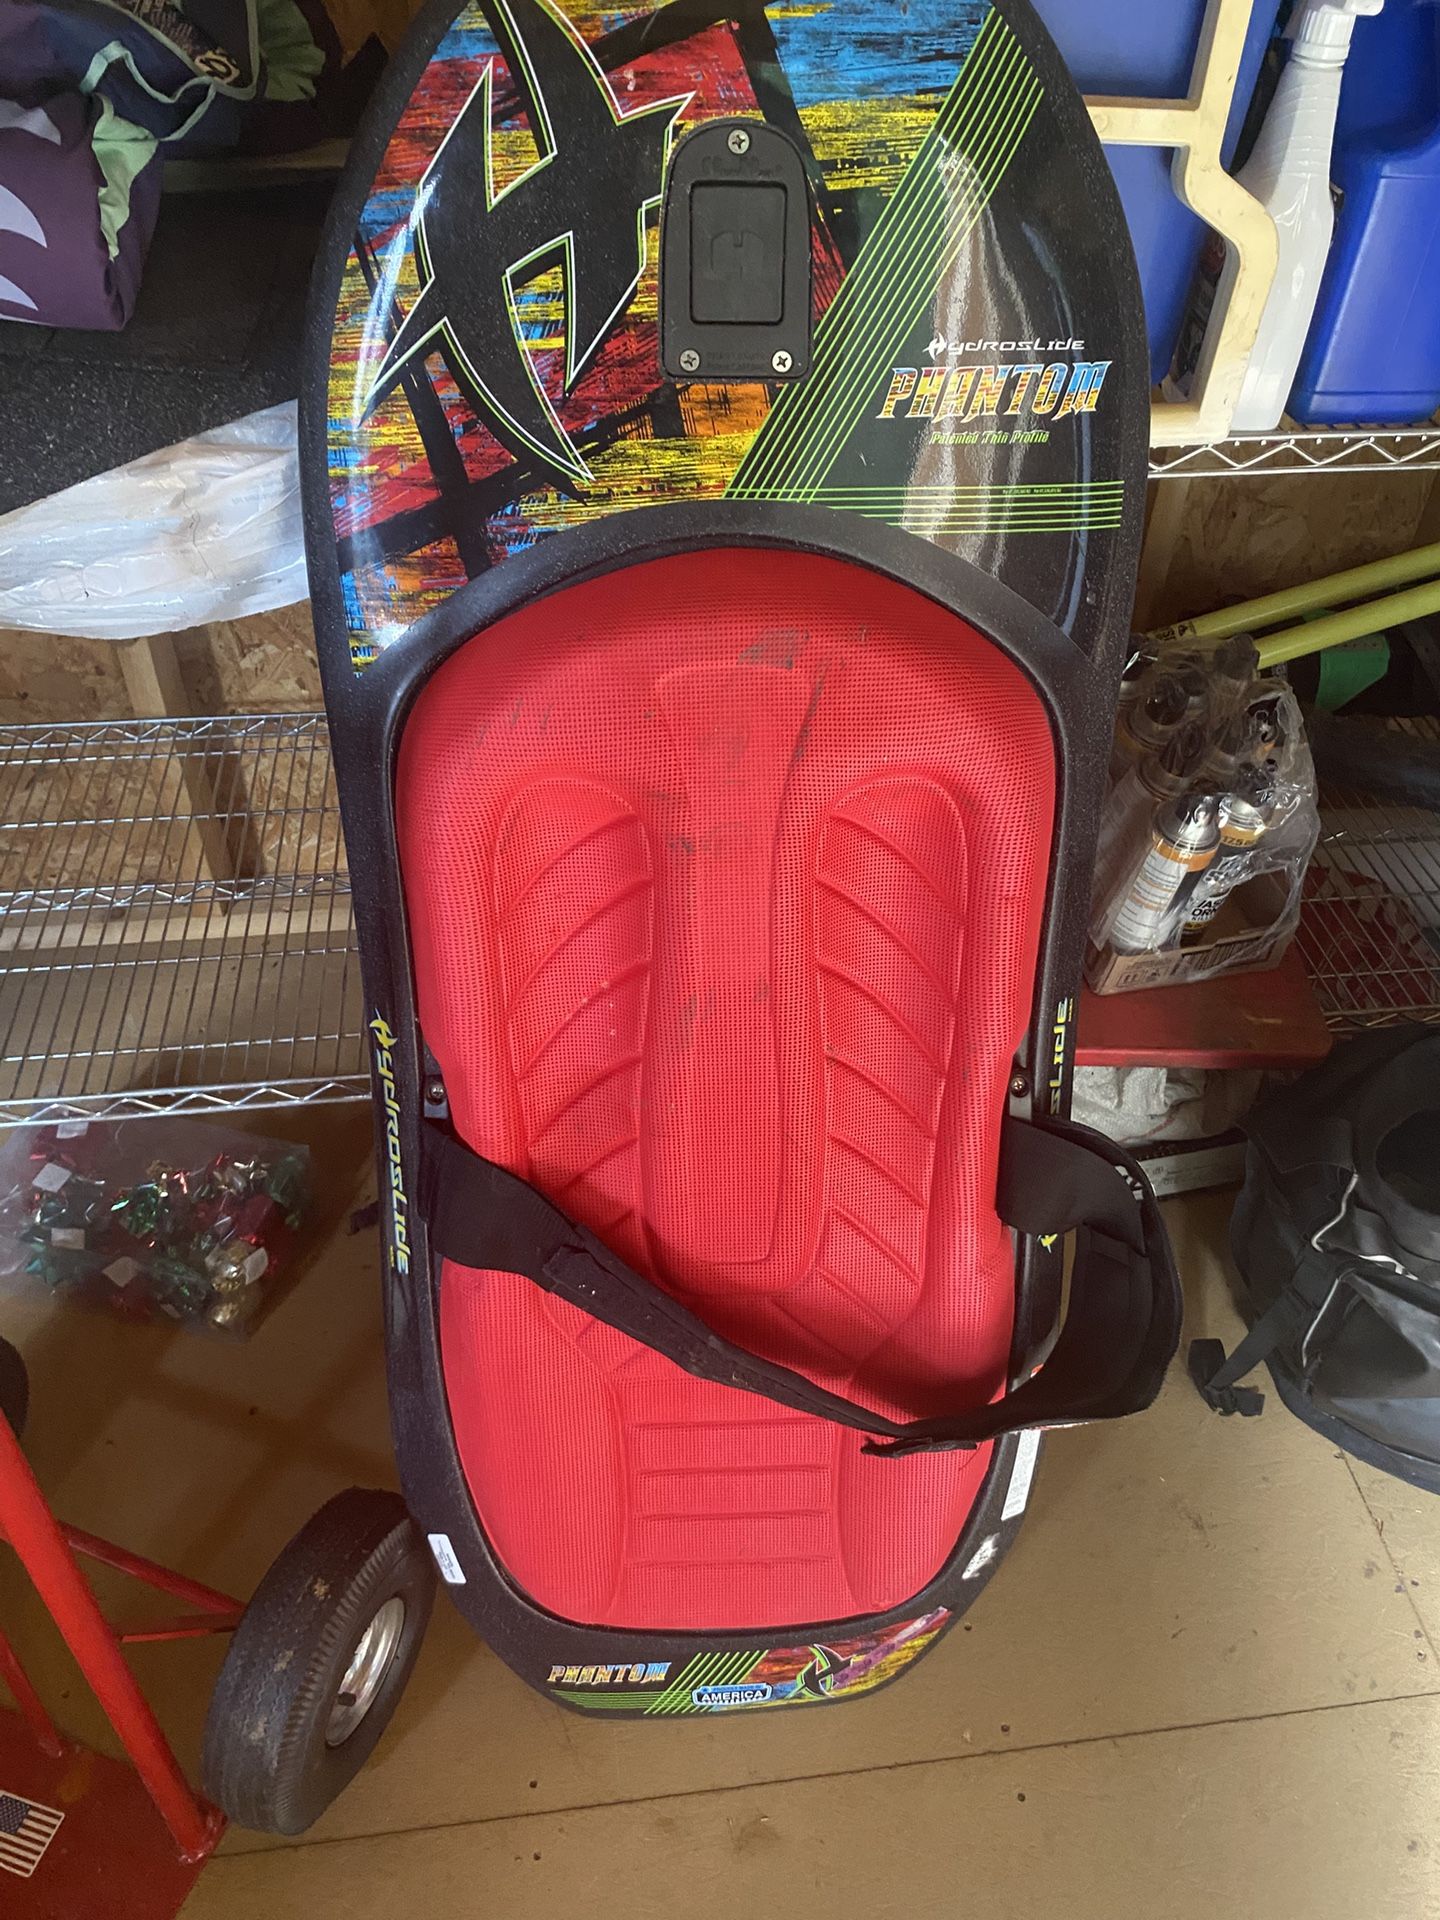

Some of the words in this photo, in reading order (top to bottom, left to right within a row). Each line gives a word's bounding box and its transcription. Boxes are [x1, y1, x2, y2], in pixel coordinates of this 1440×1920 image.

[876, 361, 1113, 423] PHANTOM
[929, 431, 980, 445] Patented
[981, 431, 1010, 444] Thin
[1009, 430, 1050, 444] Profile
[547, 1662, 672, 1685] PHANTOM
[702, 1690, 763, 1702] AMERICA
